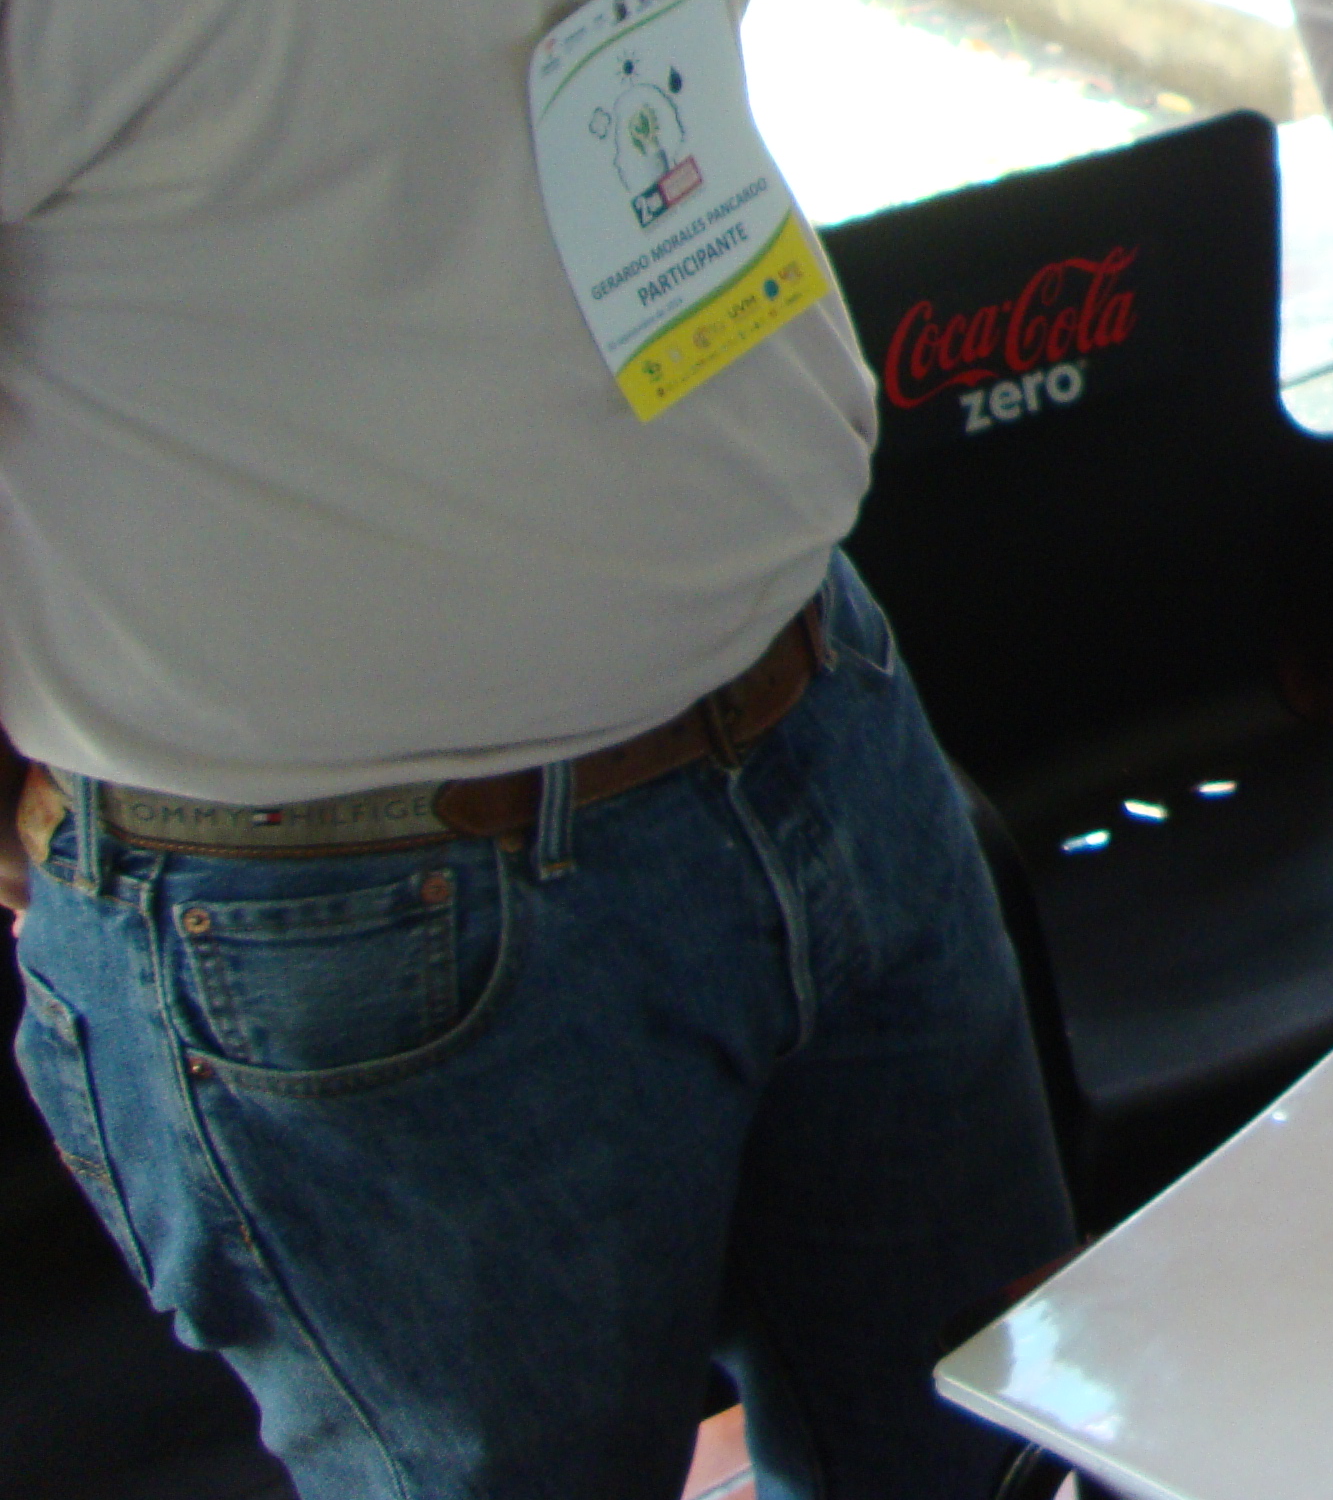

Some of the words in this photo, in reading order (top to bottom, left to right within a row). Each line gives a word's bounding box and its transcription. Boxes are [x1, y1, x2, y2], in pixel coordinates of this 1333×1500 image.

[590, 253, 649, 300] GERARDO
[650, 217, 706, 262] MORALES
[637, 221, 748, 306] PARTICIPANTE
[884, 244, 1140, 409] Coca-Cola
[958, 361, 1083, 434] zero
[292, 794, 430, 826] HILFIGE
